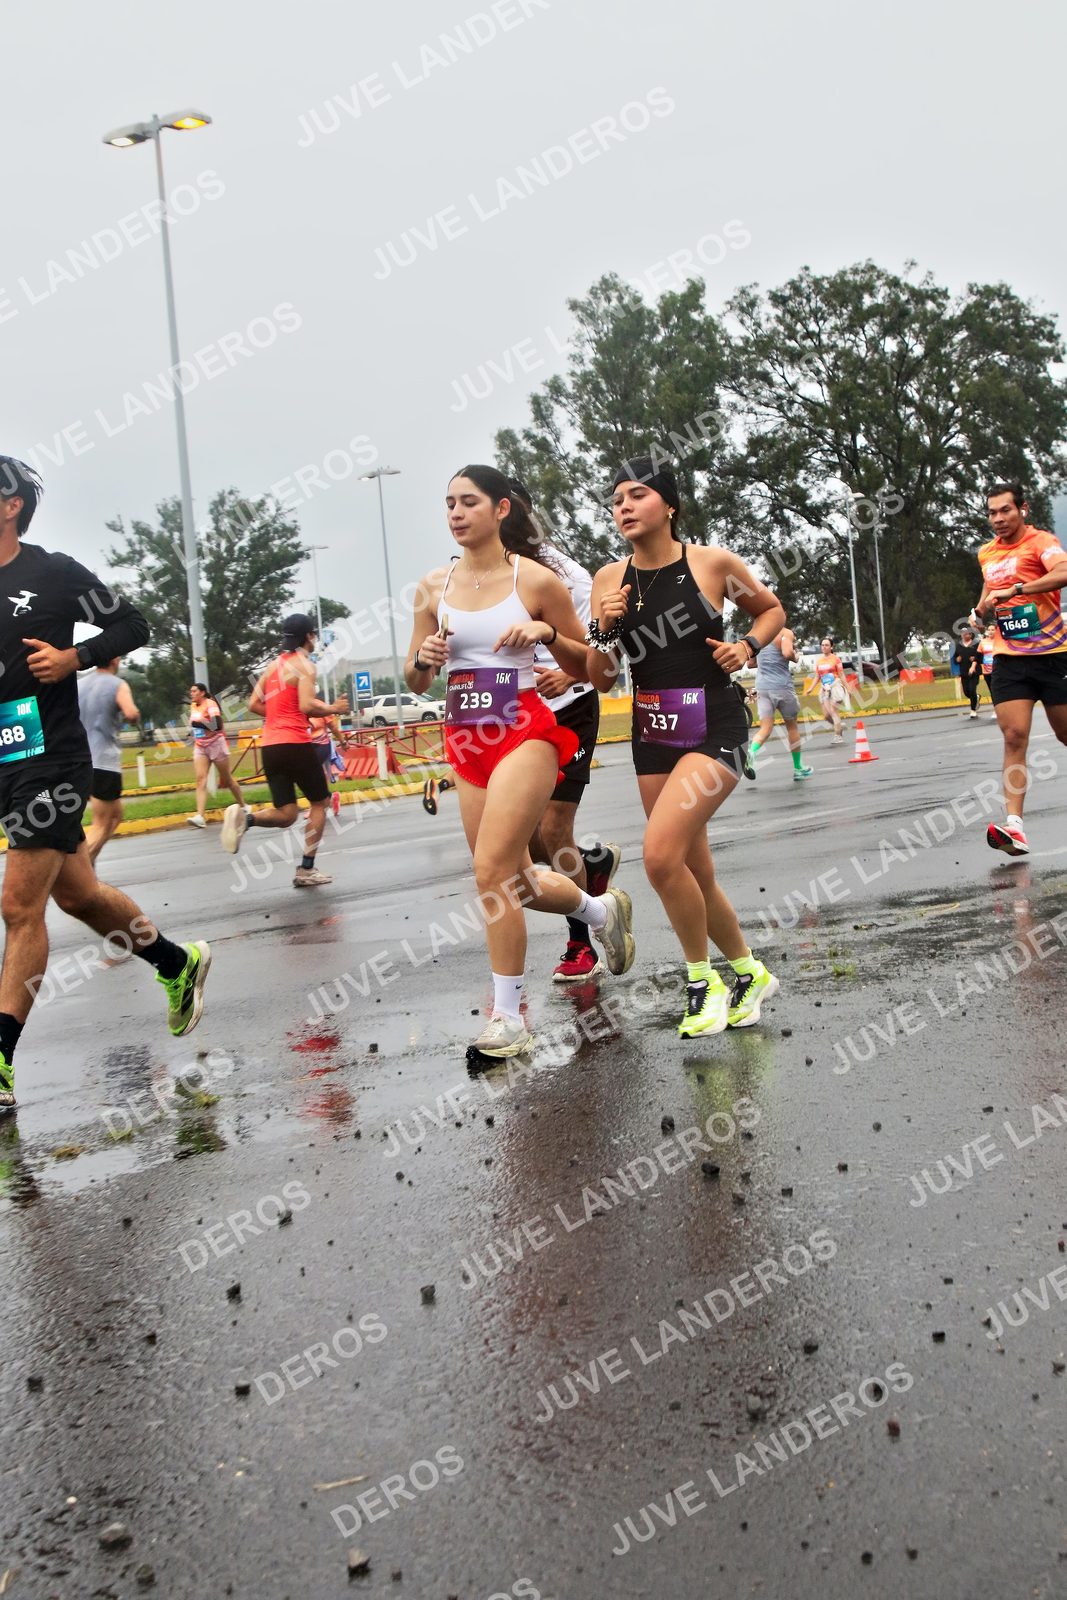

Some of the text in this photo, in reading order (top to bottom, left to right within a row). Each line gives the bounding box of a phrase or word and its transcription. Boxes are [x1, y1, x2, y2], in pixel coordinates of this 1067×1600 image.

[1003, 618, 1029, 630] 1648
[460, 692, 492, 710] 239
[16, 702, 32, 716] 10K
[648, 713, 678, 730] 237
